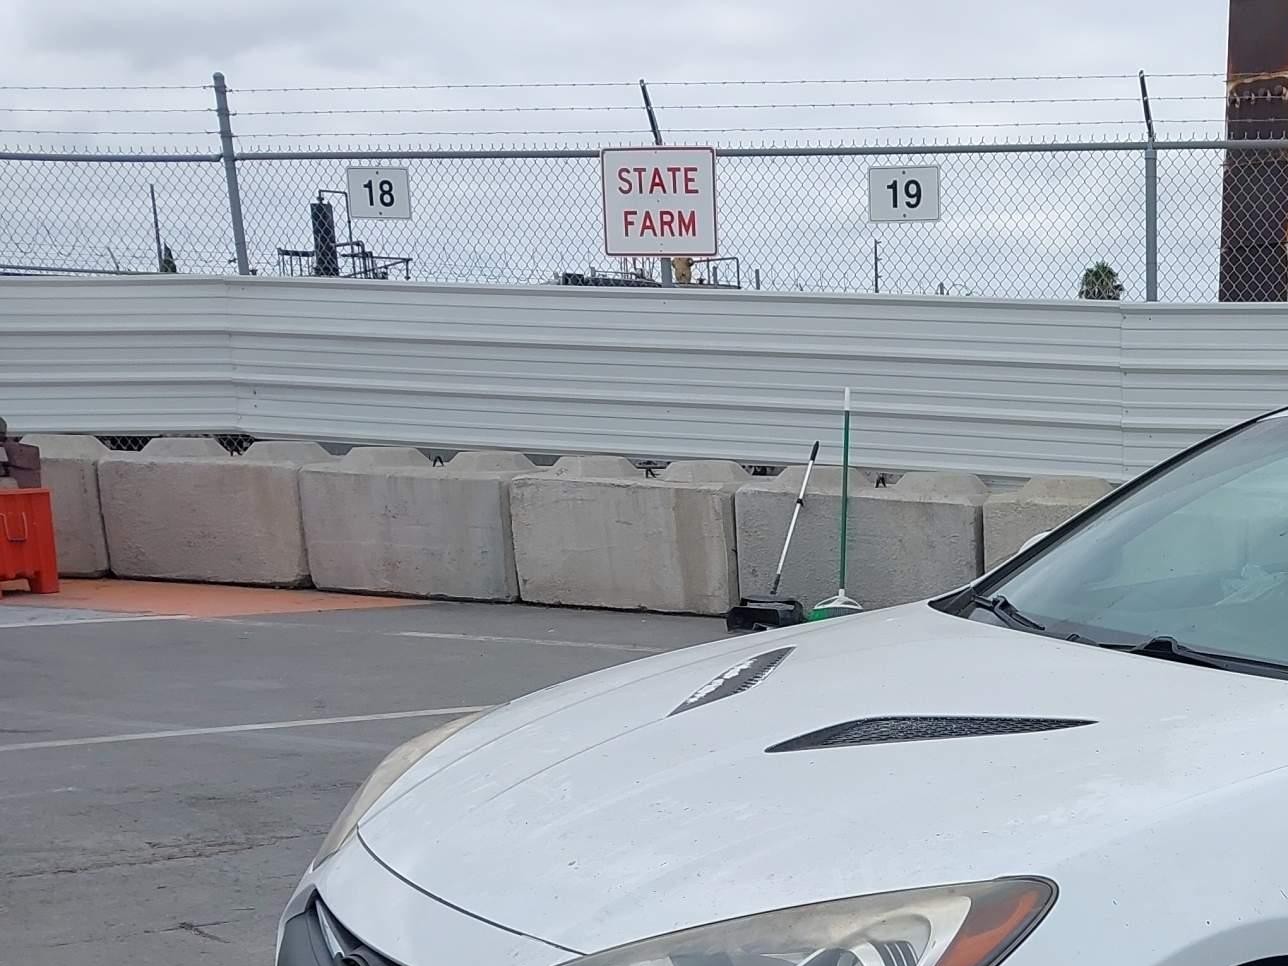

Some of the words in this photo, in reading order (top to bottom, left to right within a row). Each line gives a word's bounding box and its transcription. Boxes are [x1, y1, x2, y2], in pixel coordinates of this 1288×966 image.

[363, 179, 395, 207] 18
[618, 167, 699, 194] STATE
[886, 179, 922, 209] 19
[623, 210, 696, 237] FARM
